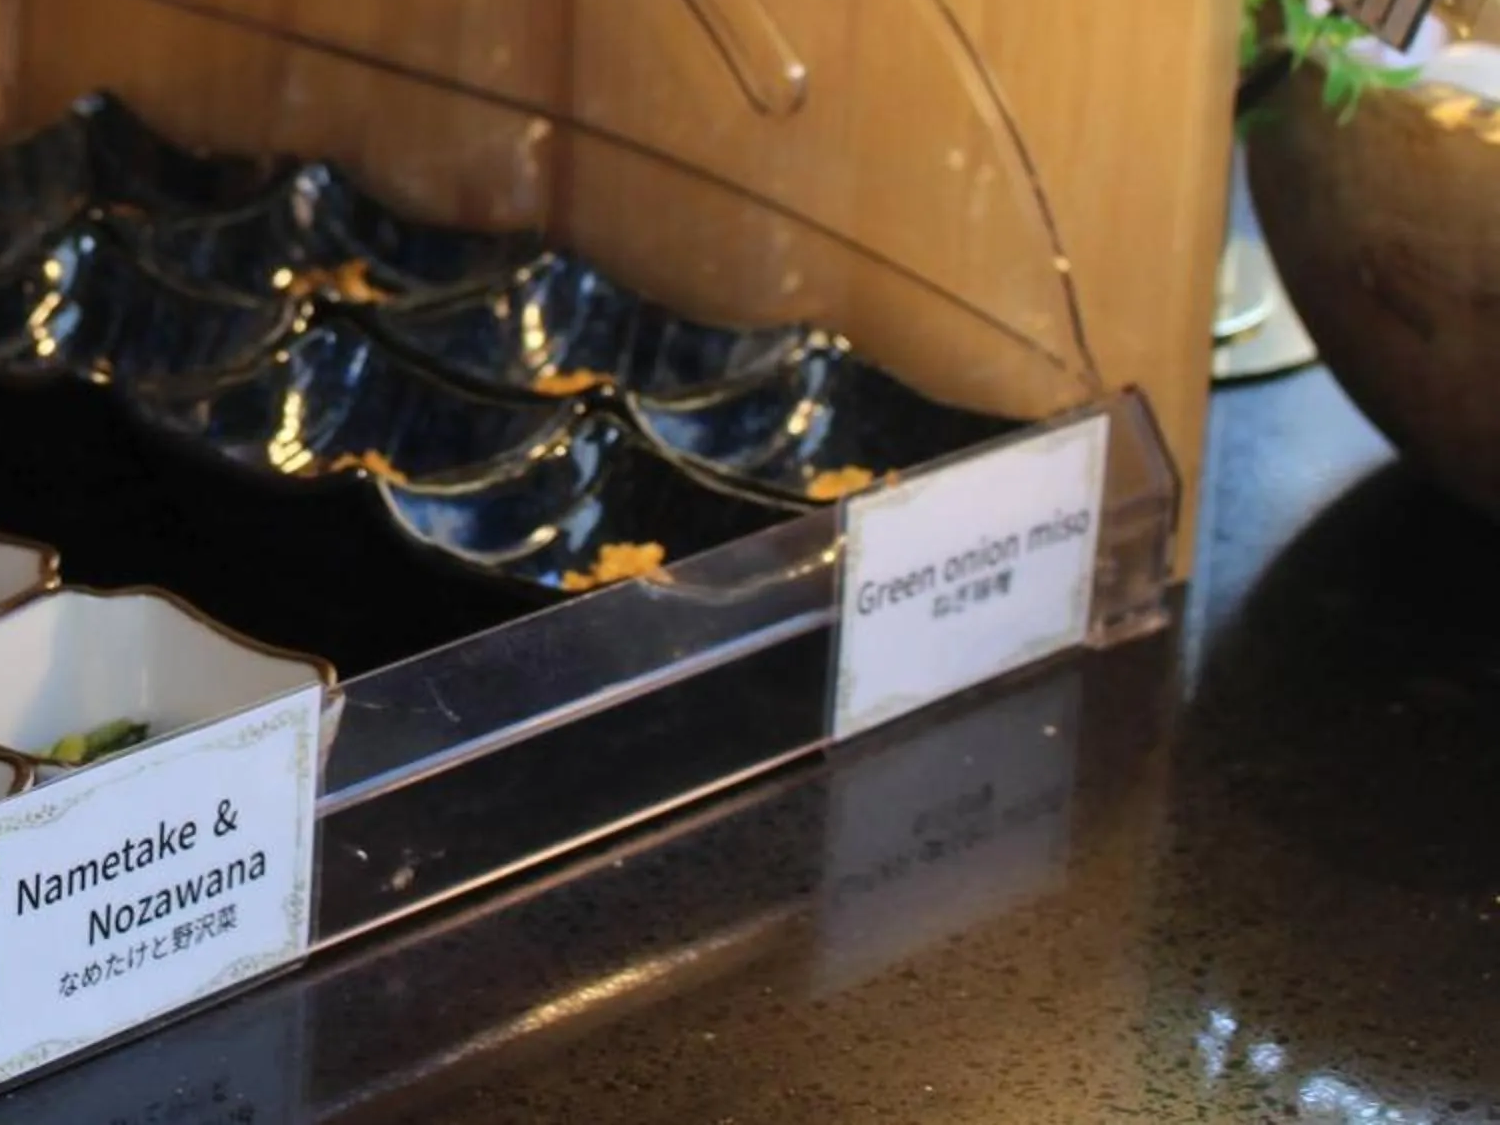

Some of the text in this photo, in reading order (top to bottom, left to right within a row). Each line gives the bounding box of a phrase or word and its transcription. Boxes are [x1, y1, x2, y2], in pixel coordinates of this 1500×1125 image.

[858, 508, 1090, 615] Green onion miso
[16, 798, 238, 915] Nametake &
[88, 850, 266, 945] Nozawana
[59, 905, 238, 996] なめたけと野沢菜
